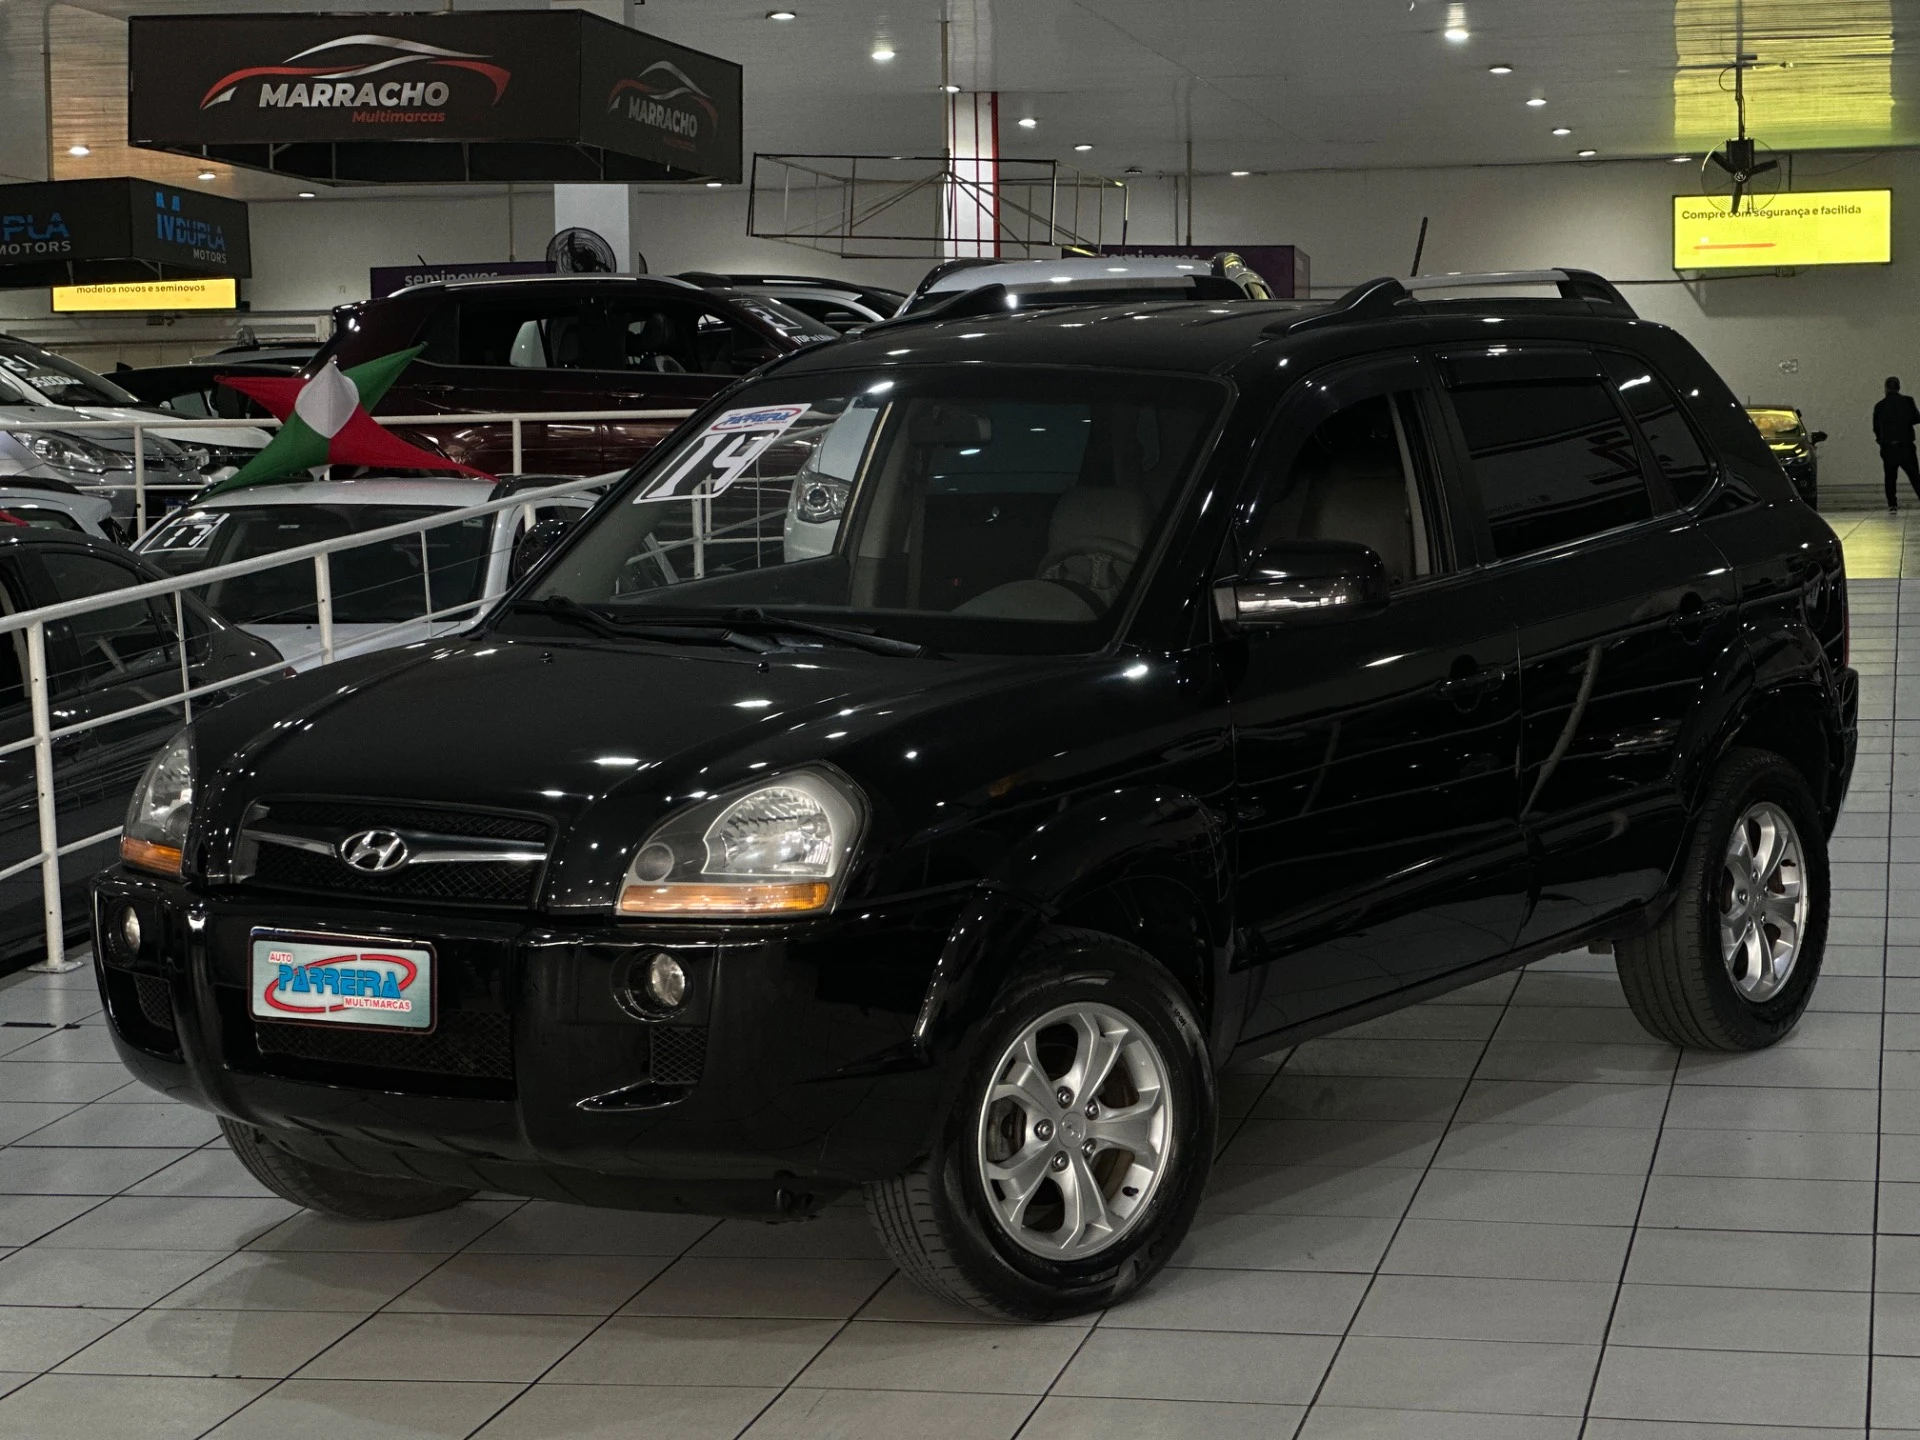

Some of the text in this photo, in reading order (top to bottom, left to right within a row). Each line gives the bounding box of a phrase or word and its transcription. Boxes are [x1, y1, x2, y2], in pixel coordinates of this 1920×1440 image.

[258, 81, 450, 108] MARRACHO
[352, 110, 445, 123] Multimarcas
[628, 95, 698, 138] MARRACHO
[1682, 210, 1726, 221] Compre
[1753, 207, 1811, 220] segurança
[1820, 204, 1862, 215] facilida
[193, 248, 227, 264] MOTORS
[76, 284, 117, 294] modelos
[118, 284, 147, 293] novos
[155, 282, 206, 292] seminovos
[646, 432, 775, 498] 14
[163, 524, 212, 547] 17
[269, 952, 292, 963] AUTO
[278, 964, 402, 999] PARREIRA
[344, 997, 411, 1010] MULTIMARCAS
